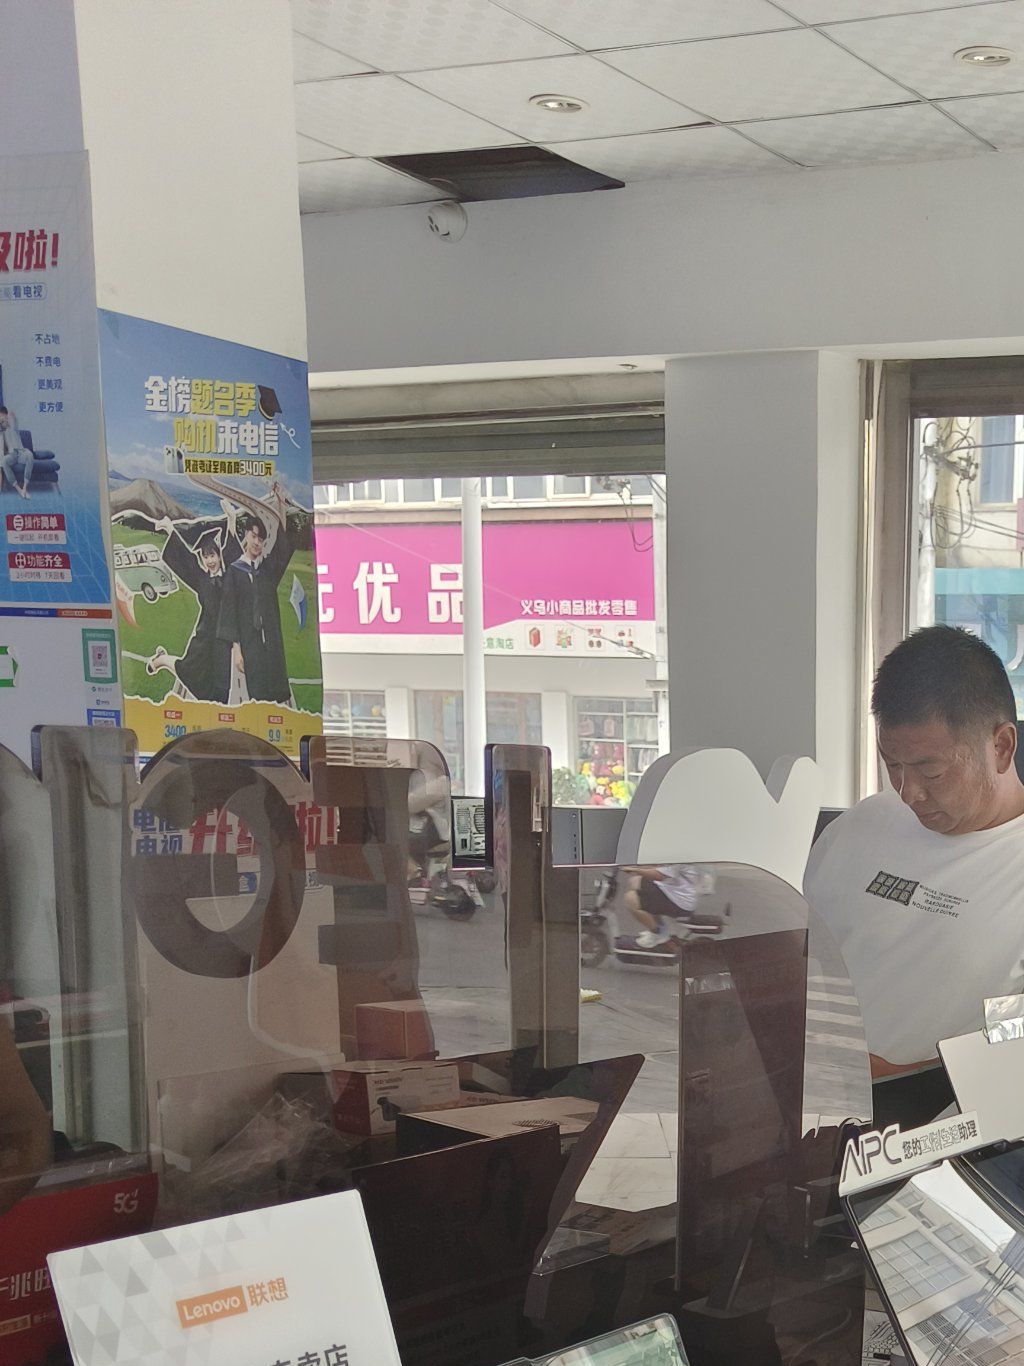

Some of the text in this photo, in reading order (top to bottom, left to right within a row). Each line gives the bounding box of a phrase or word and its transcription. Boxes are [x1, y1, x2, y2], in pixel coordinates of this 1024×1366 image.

[144, 375, 257, 417] 金榜题名季
[174, 417, 279, 456] 购机来电信
[26, 556, 63, 568] 功能齐全
[520, 599, 638, 616] 义乌小商品批发零售
[183, 1277, 289, 1321] Lenovo 联想
